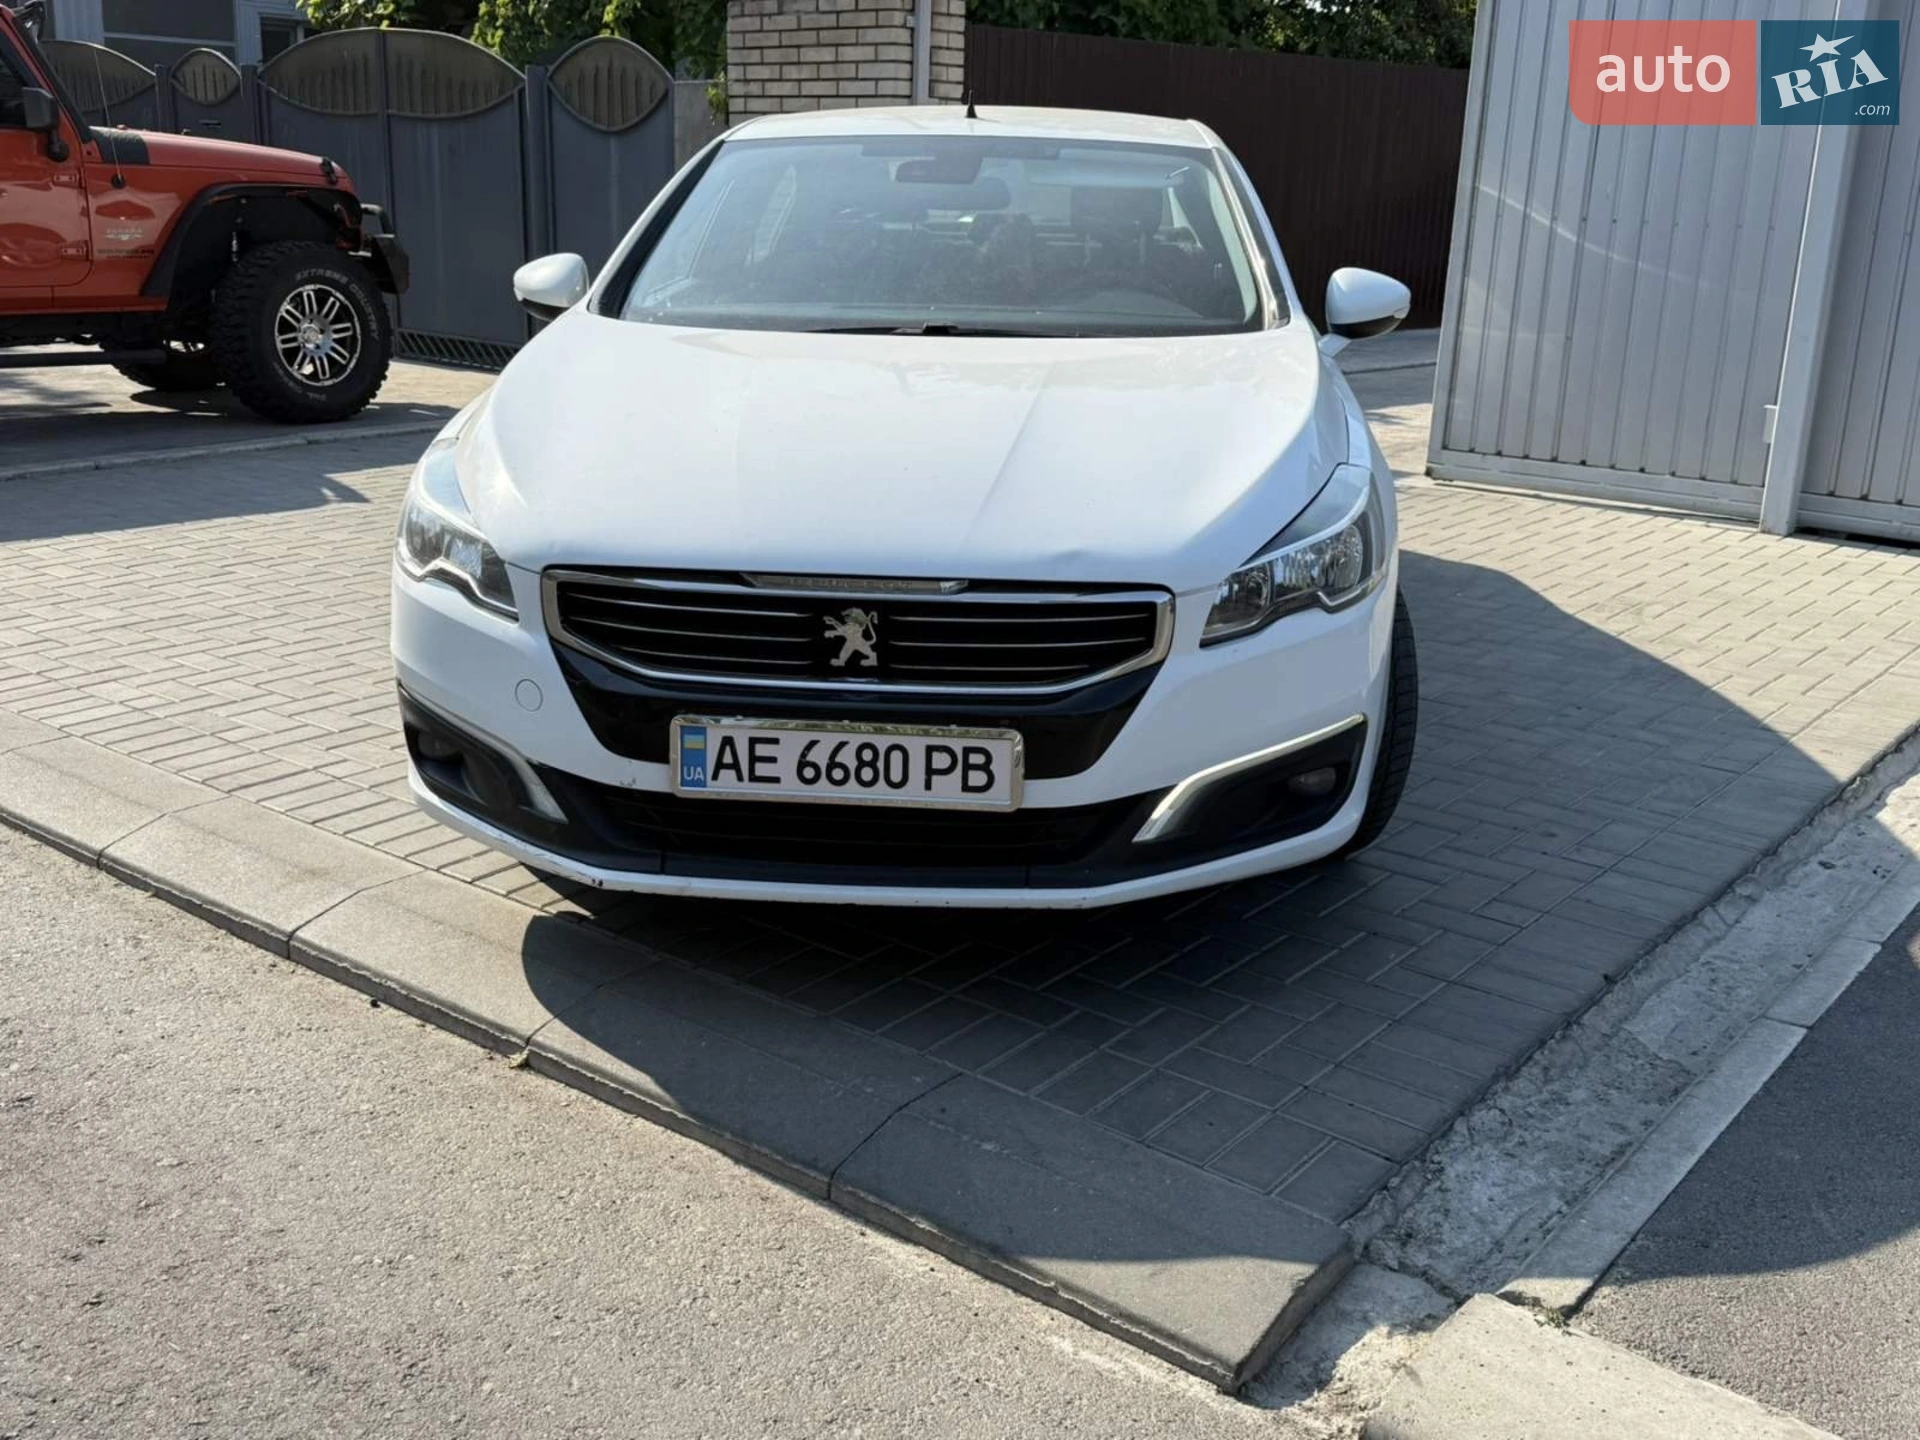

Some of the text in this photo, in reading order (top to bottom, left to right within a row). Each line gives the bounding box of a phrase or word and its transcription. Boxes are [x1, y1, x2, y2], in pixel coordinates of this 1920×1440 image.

[683, 766, 705, 781] UA
[710, 735, 996, 794] AE 6680 PB
